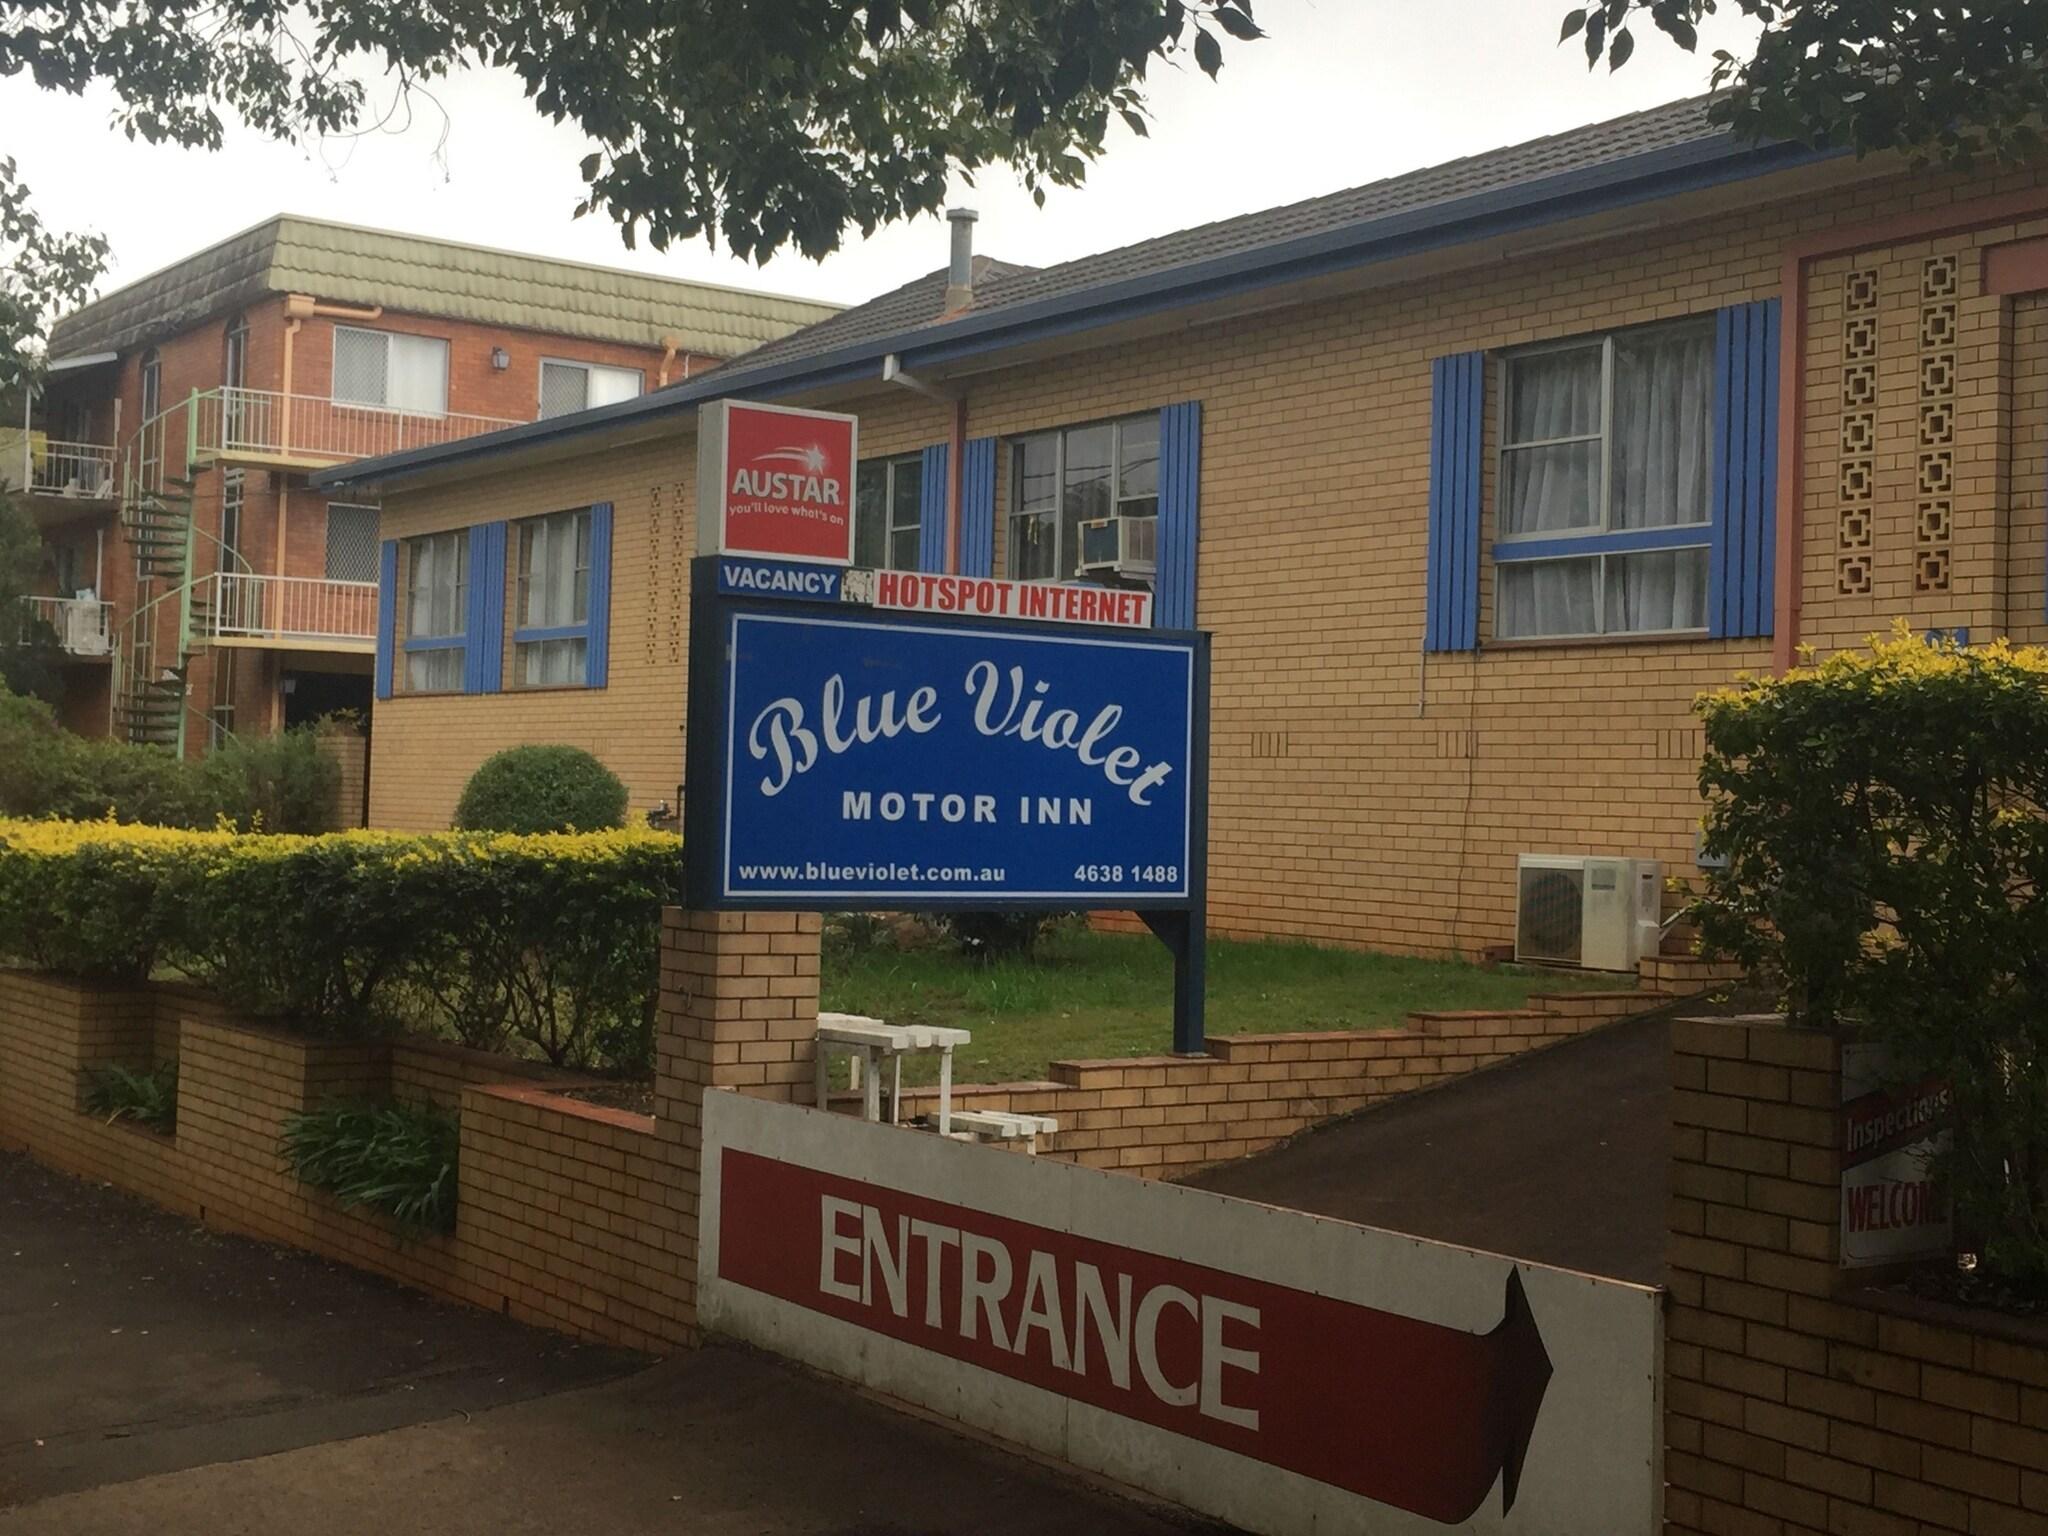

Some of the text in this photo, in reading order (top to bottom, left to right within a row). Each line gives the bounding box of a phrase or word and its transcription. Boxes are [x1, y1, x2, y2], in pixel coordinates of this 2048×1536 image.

[732, 468, 840, 505] AUSTAR
[729, 502, 844, 526] you'll love what's on
[723, 566, 836, 594] VACANCY
[879, 573, 1147, 625] HOTSPOT INTERNET
[749, 660, 1173, 806] Blue Violet
[842, 791, 1093, 825] MOTOR INN
[739, 862, 1006, 882] www.blueviolet.com.au
[1074, 864, 1178, 882] 4638 1488
[819, 1194, 1261, 1432] ENTRANCE
